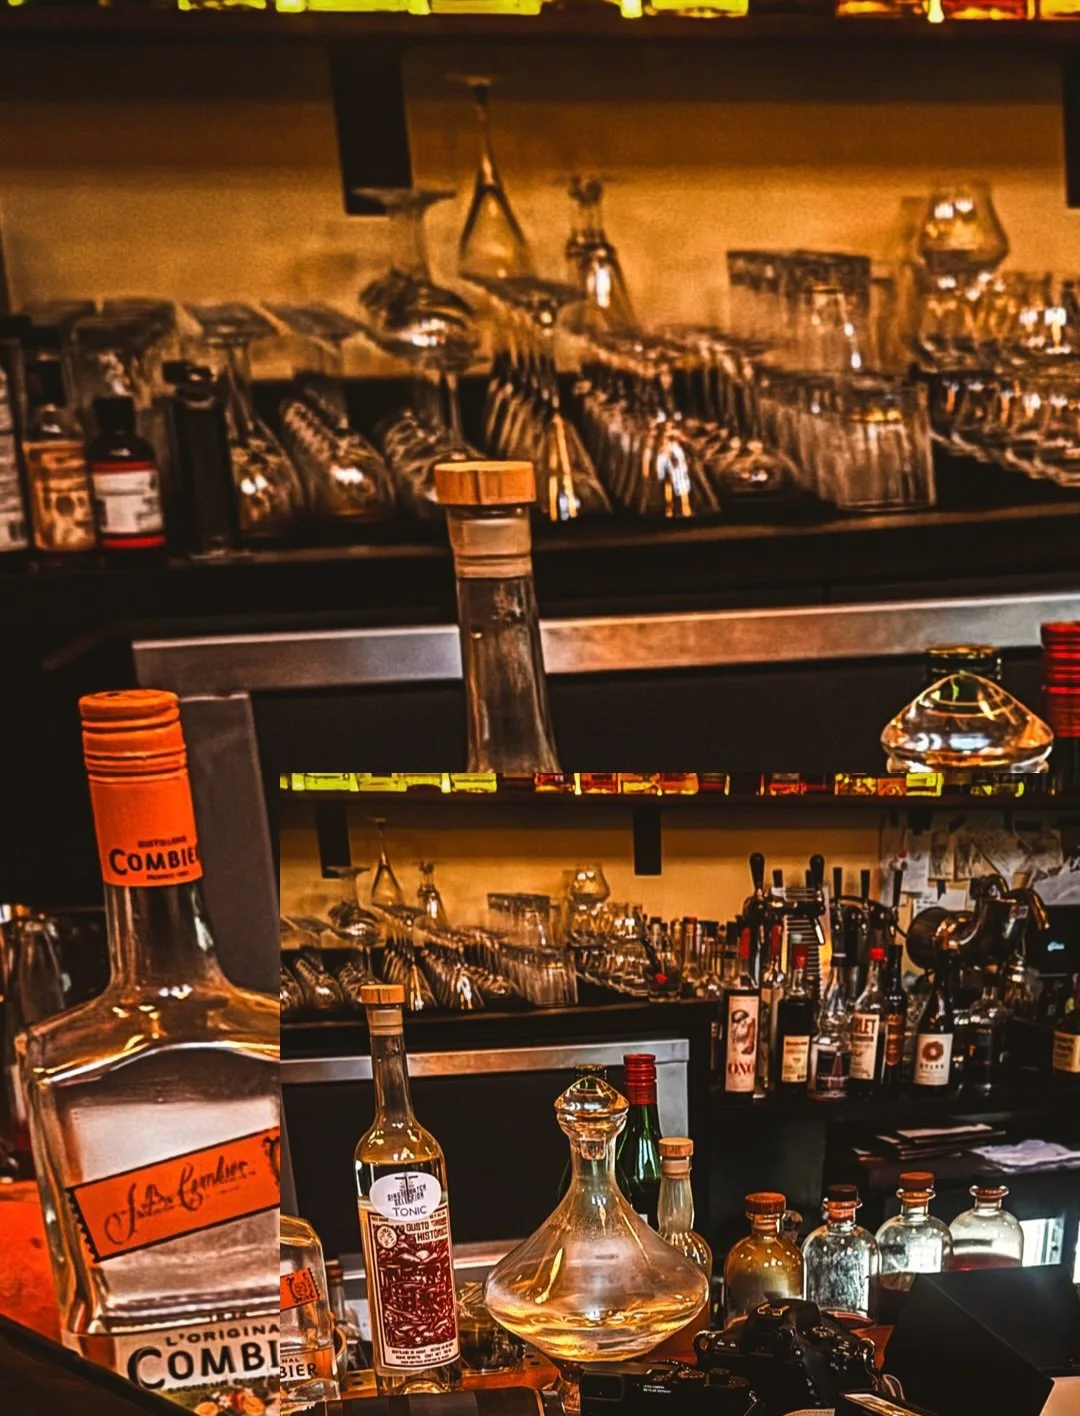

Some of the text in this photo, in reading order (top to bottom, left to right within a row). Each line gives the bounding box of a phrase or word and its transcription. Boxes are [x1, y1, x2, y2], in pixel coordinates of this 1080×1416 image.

[392, 1205, 427, 1217] TONIC
[406, 1221, 430, 1232] GUSTO
[166, 1324, 280, 1346] L'ORIGINA
